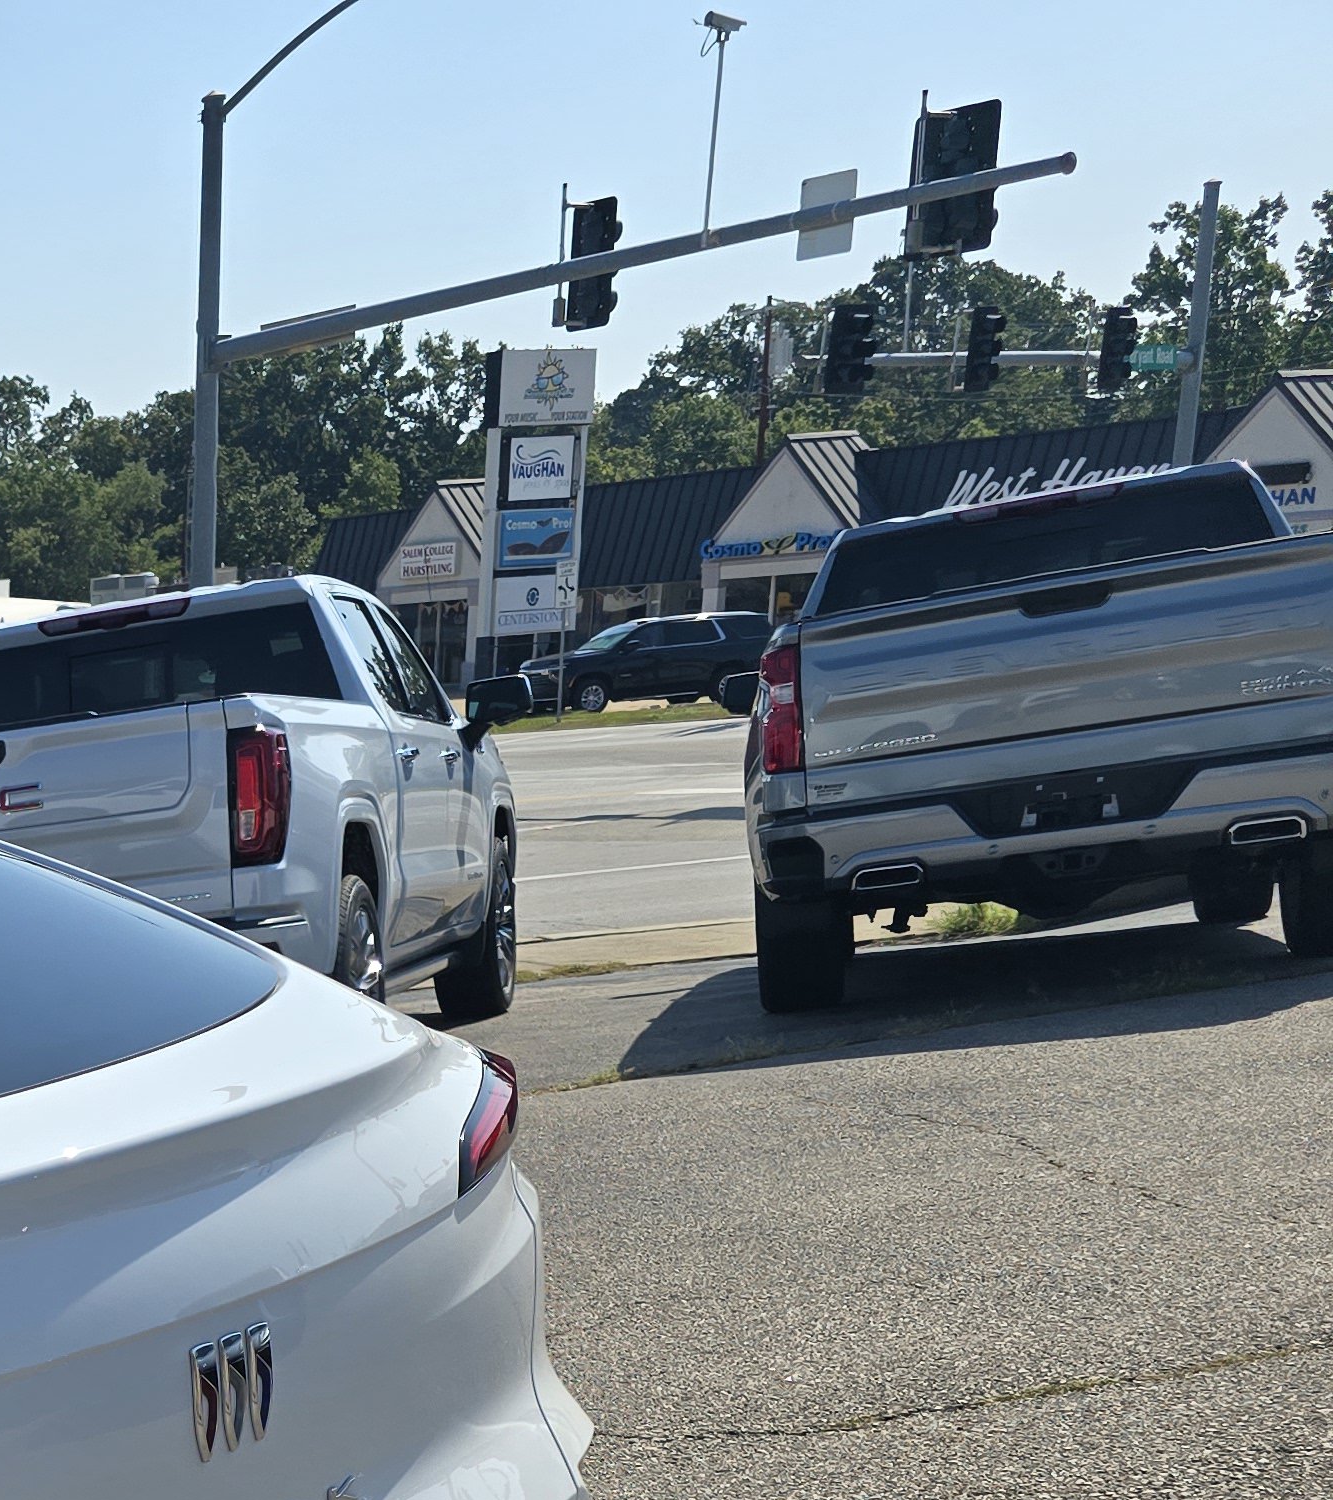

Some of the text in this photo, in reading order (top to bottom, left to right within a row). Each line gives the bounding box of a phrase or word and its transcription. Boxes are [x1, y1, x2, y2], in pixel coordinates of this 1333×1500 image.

[511, 461, 565, 479] VAUGHAN
[941, 466, 1039, 507] West
[505, 516, 573, 531] Cosmo Prof
[402, 544, 454, 559] SALEM COLLEGE
[700, 538, 762, 560] Cosmo
[402, 562, 453, 578] HAIRSTYLING
